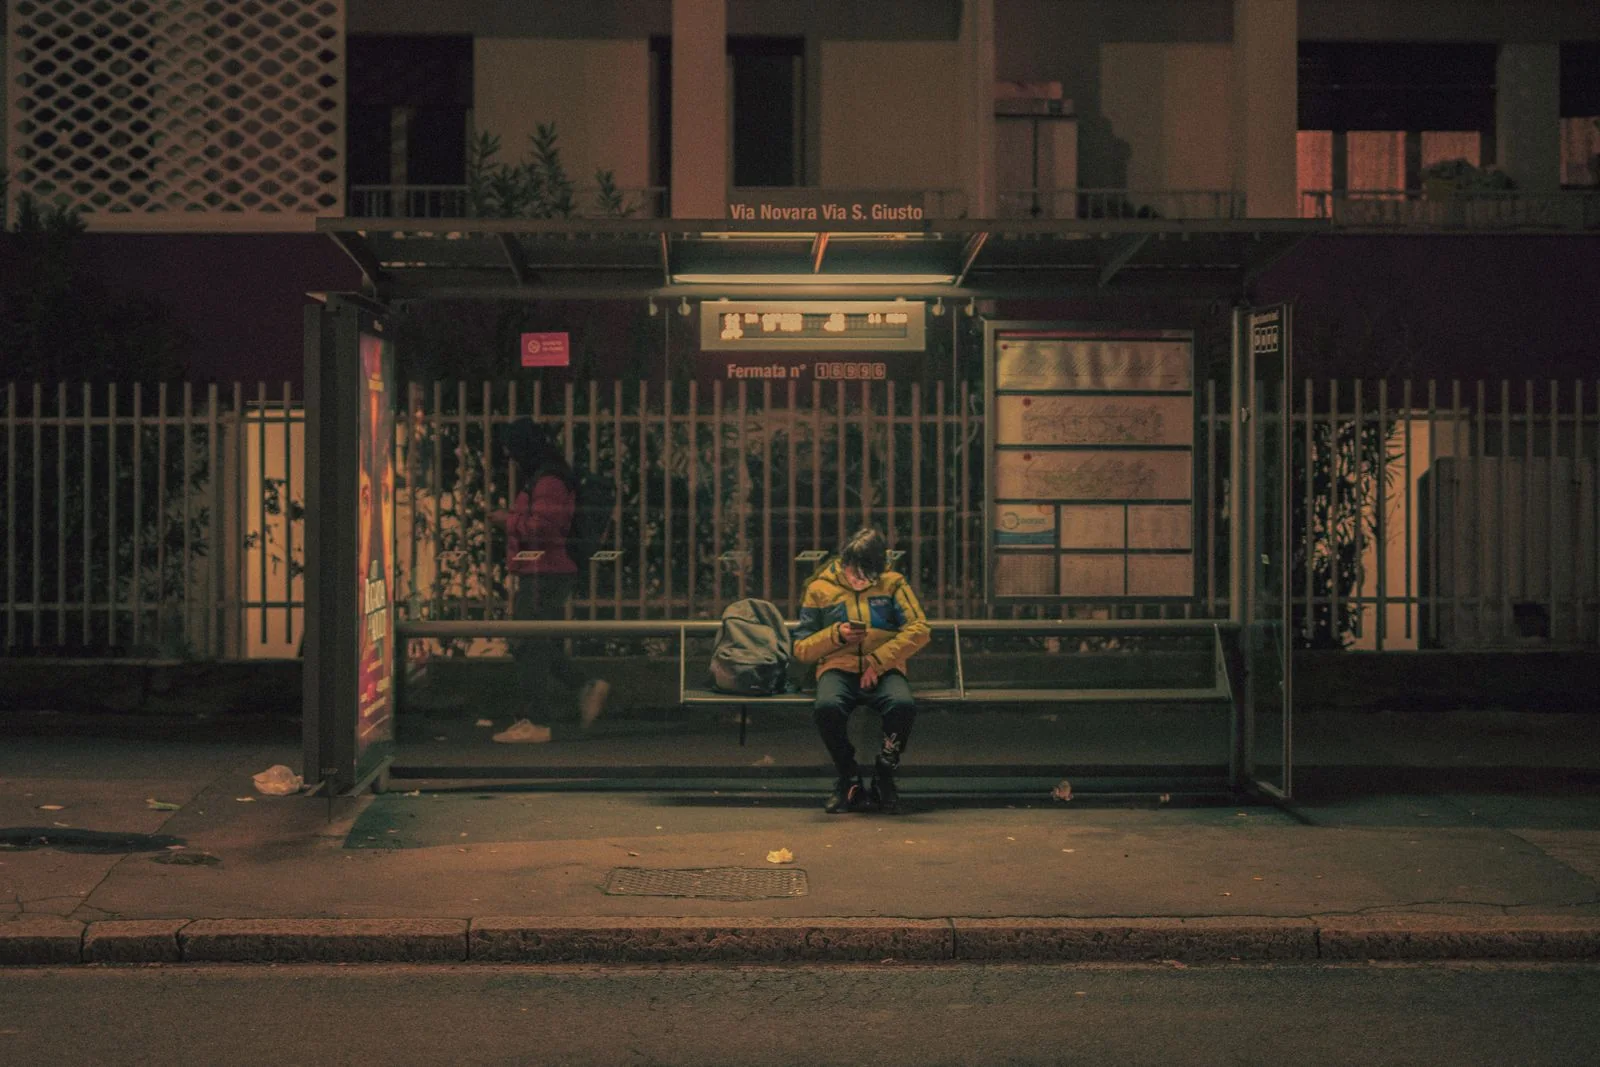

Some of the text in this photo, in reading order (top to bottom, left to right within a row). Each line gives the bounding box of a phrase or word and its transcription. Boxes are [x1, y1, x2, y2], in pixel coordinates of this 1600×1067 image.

[730, 204, 923, 220] Via Novara Via S. Giusto
[727, 363, 787, 379] Fermata
